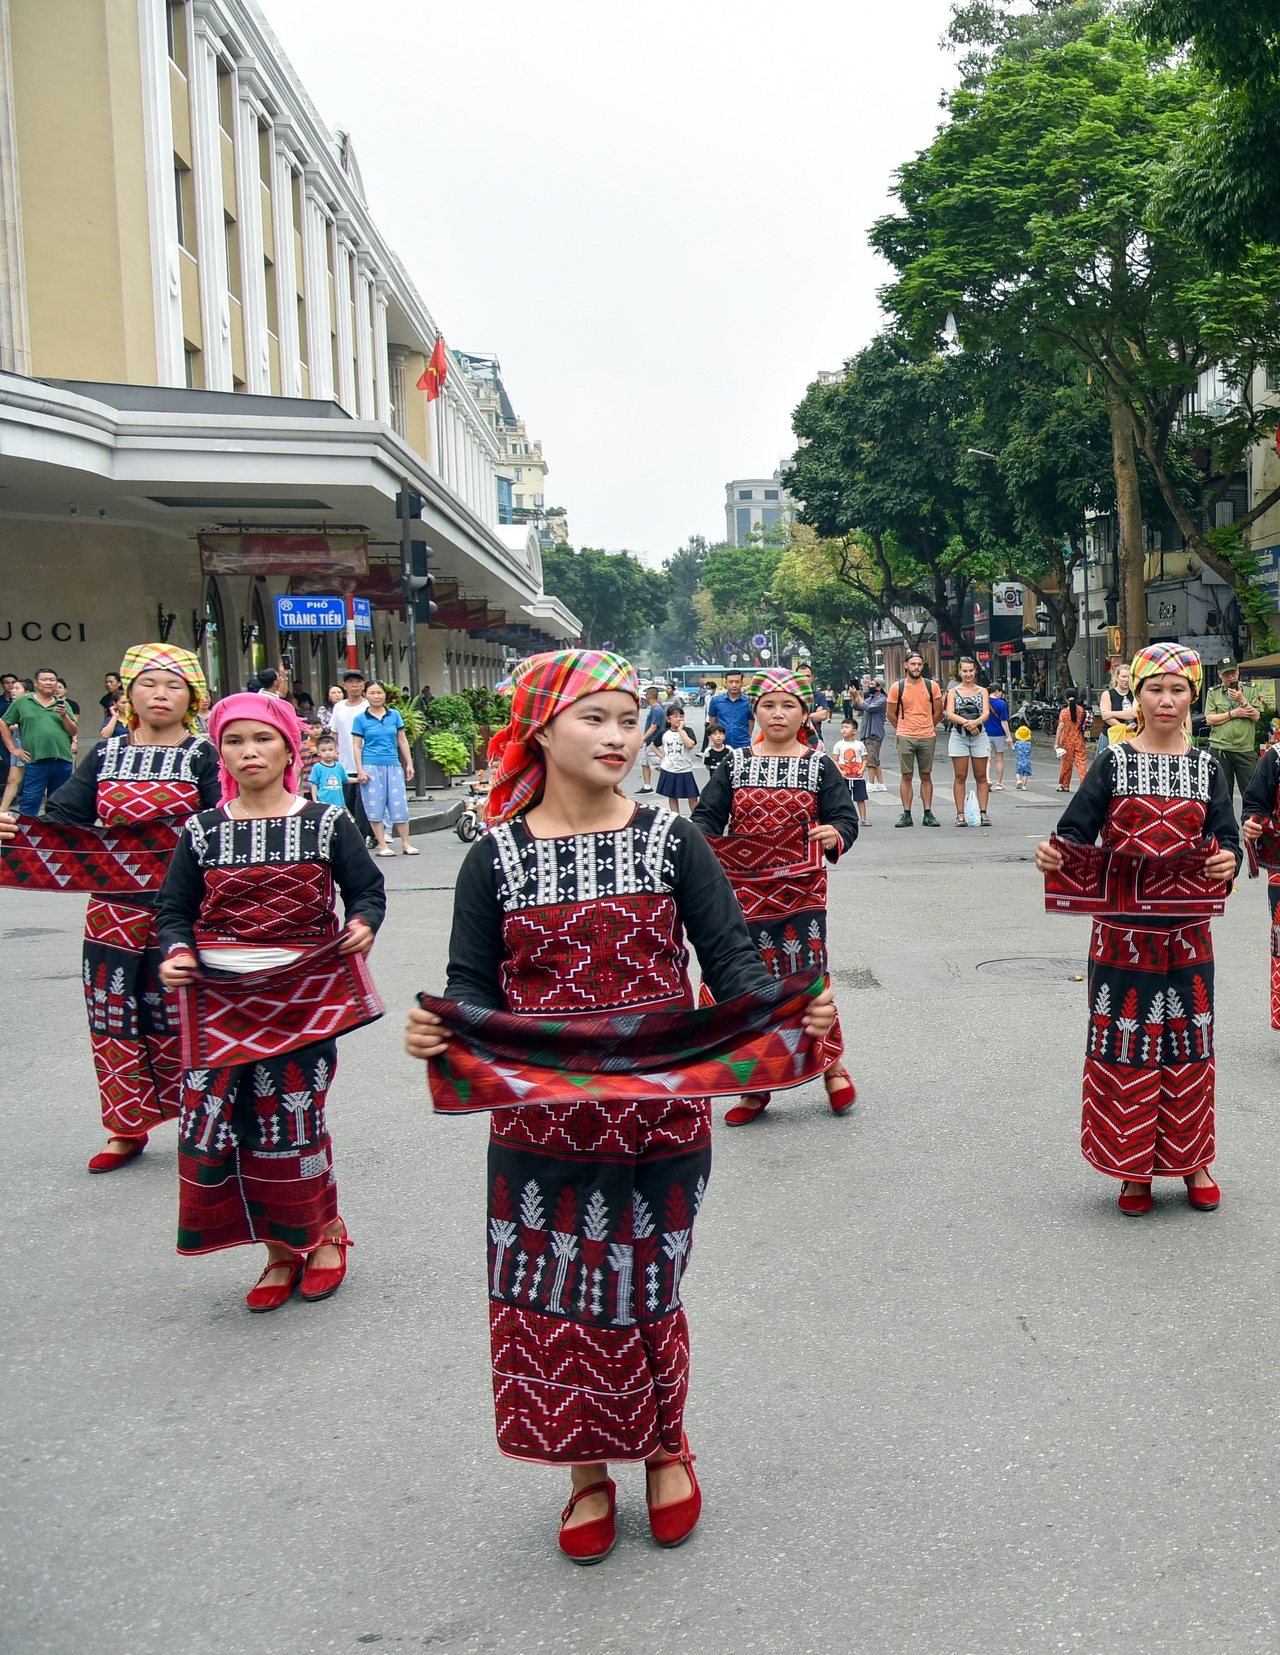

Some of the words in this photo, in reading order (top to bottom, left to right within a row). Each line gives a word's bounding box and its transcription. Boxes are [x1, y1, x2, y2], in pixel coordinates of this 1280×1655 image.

[307, 599, 328, 609] PHỐ
[283, 611, 317, 625] TRÀNG
[319, 609, 341, 625] TIỀN
